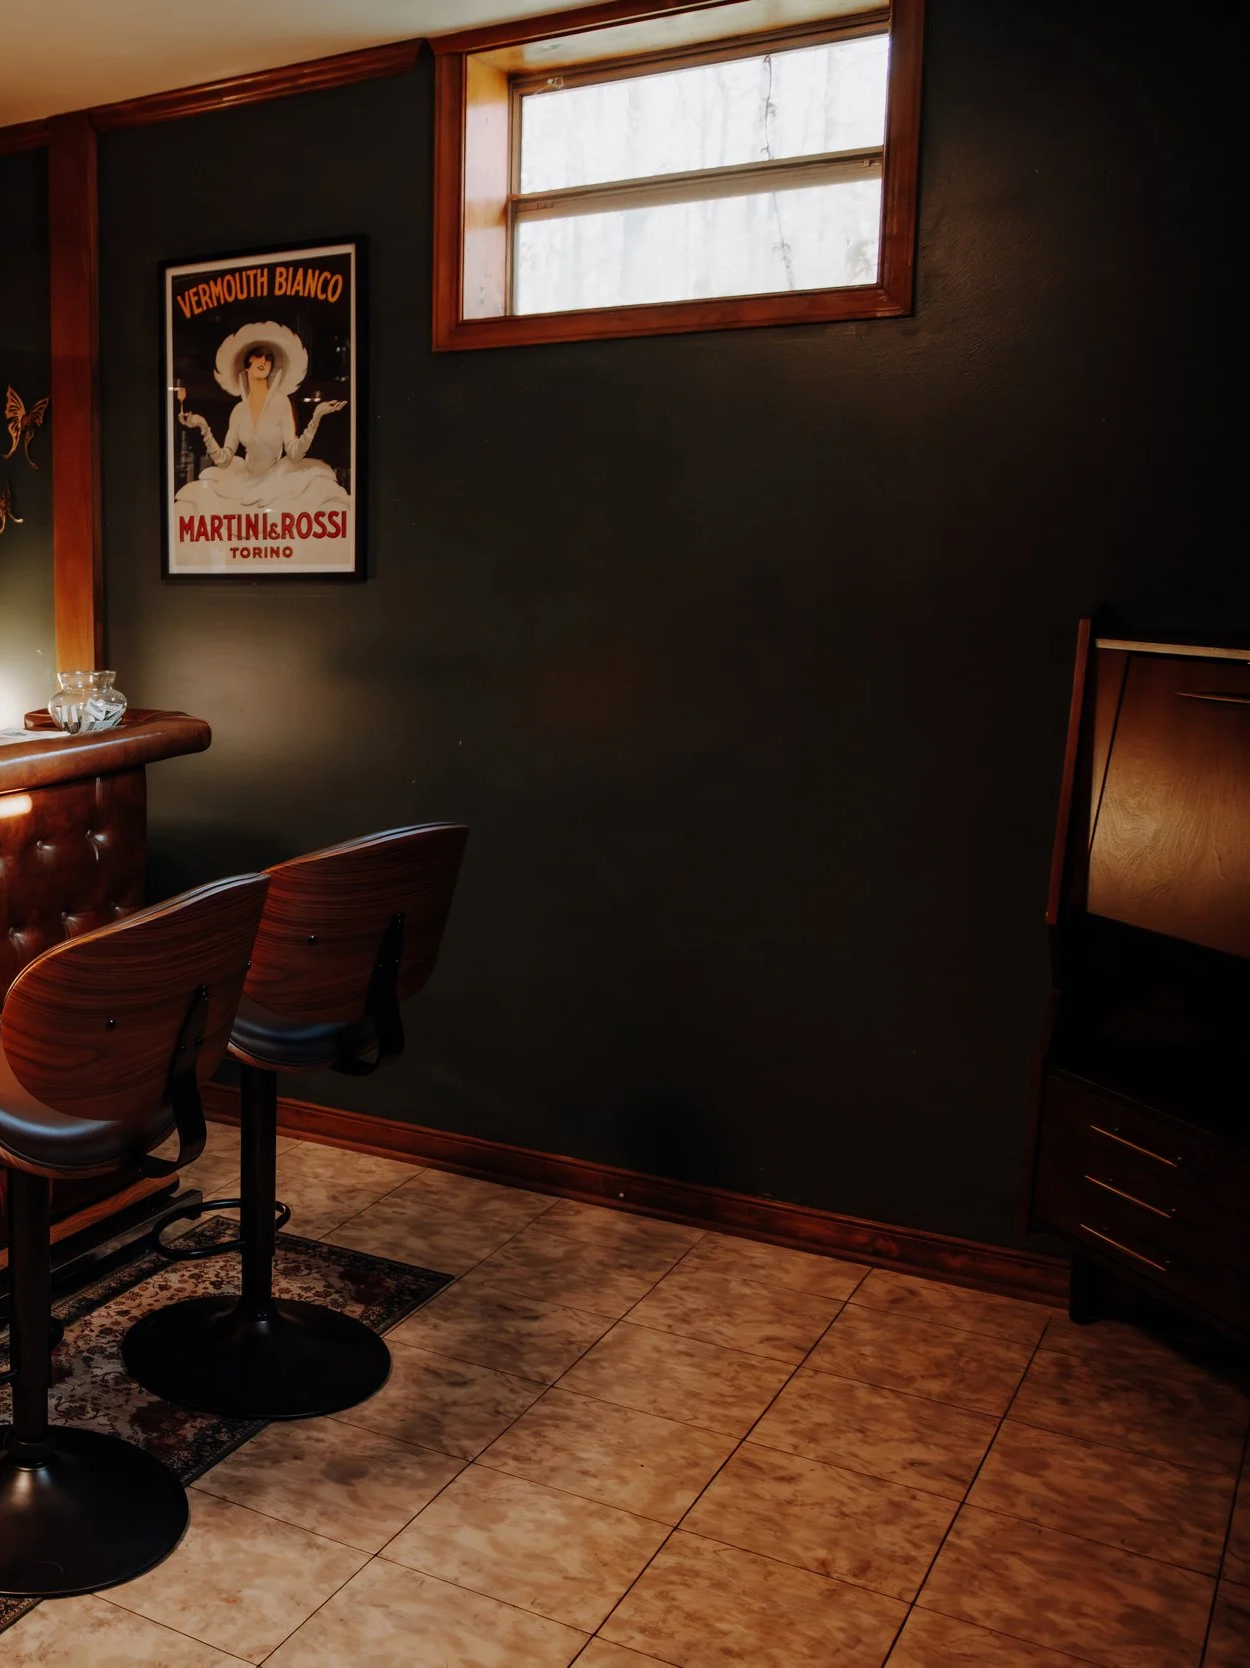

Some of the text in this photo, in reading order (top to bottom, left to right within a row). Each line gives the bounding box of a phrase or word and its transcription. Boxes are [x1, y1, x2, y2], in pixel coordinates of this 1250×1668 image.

[177, 266, 343, 319] VERMOUTH BIANCO
[229, 546, 294, 559] TORINO
